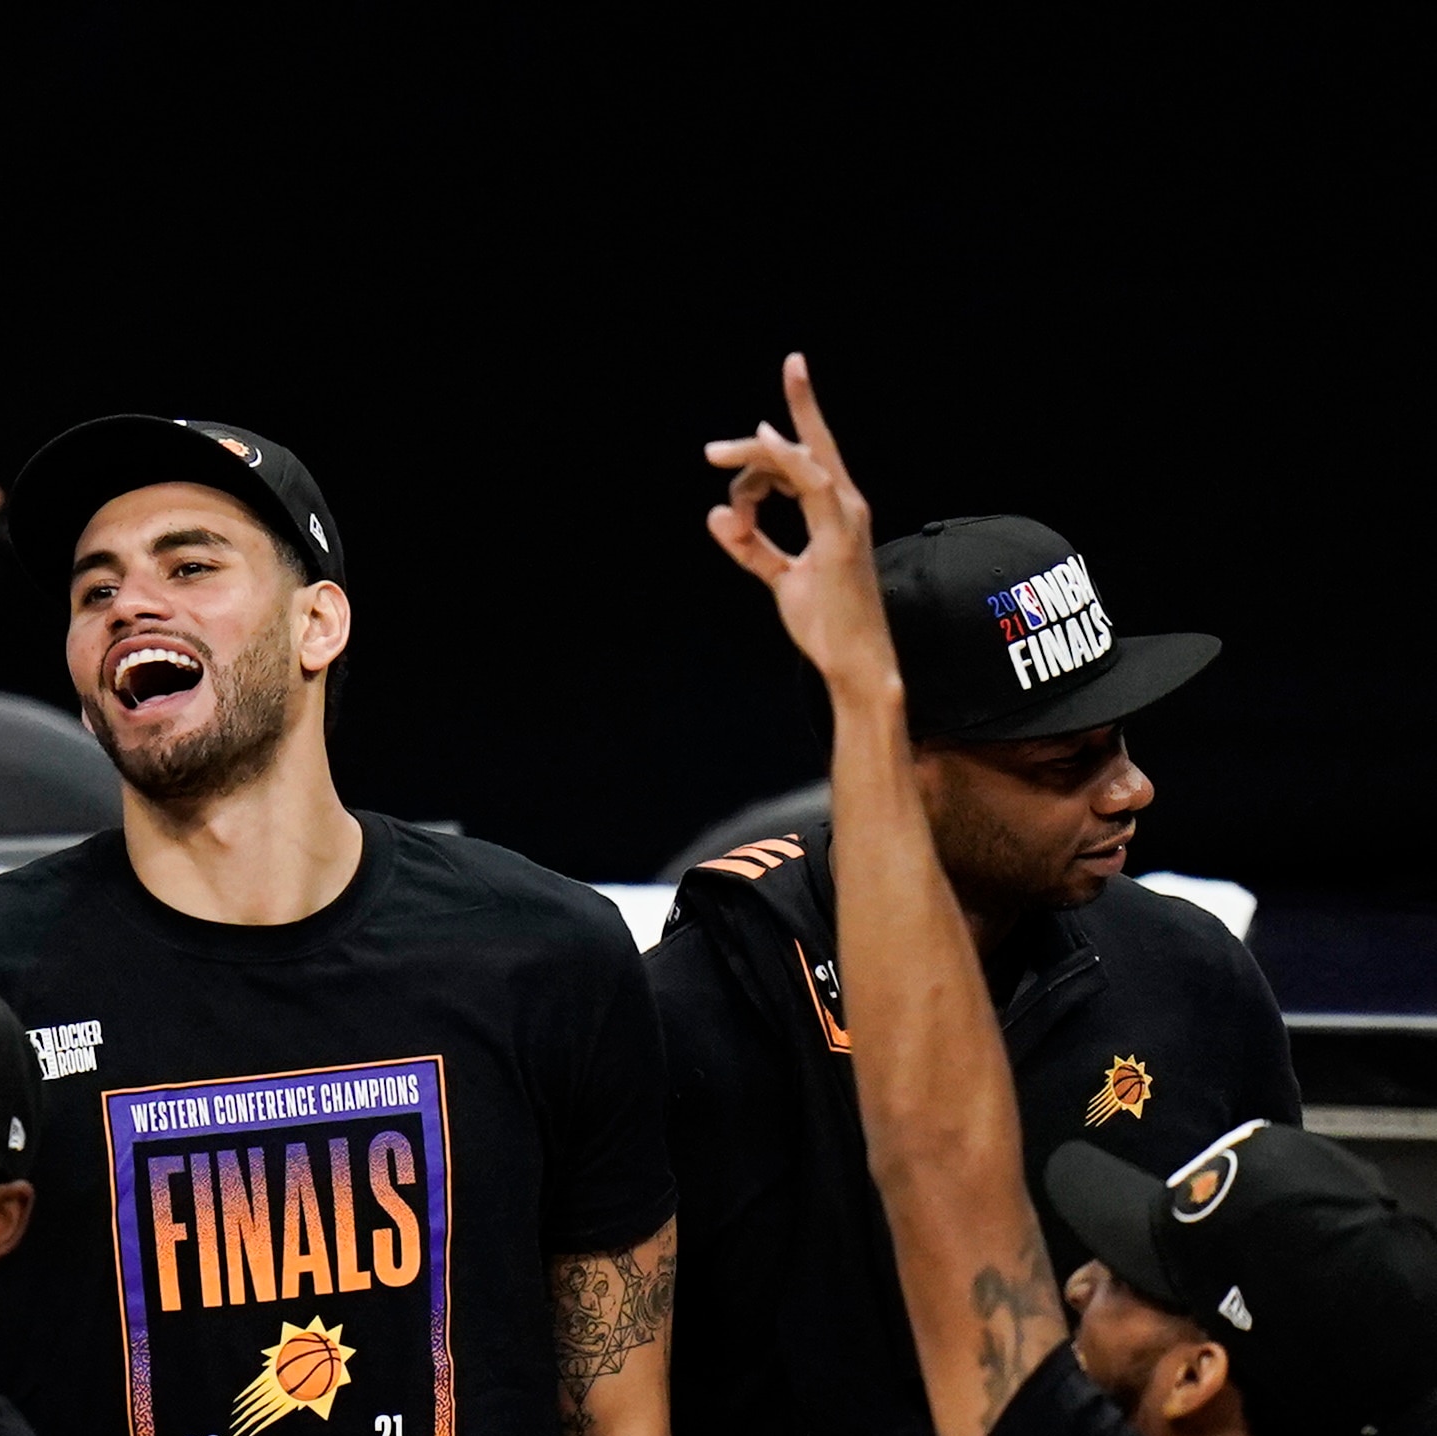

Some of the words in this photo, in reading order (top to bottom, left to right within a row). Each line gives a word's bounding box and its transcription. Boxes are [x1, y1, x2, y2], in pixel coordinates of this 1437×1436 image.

[987, 590, 1016, 618] 20
[999, 613, 1025, 641] 21
[1008, 602, 1112, 690] FINALS
[52, 1020, 104, 1052] LOCKER
[57, 1045, 98, 1078] ROOM
[130, 1097, 211, 1134] WESTERN
[213, 1085, 318, 1125] CONFERENCE
[321, 1074, 420, 1115] CHAMPIONS
[147, 1130, 422, 1312] FINALS
